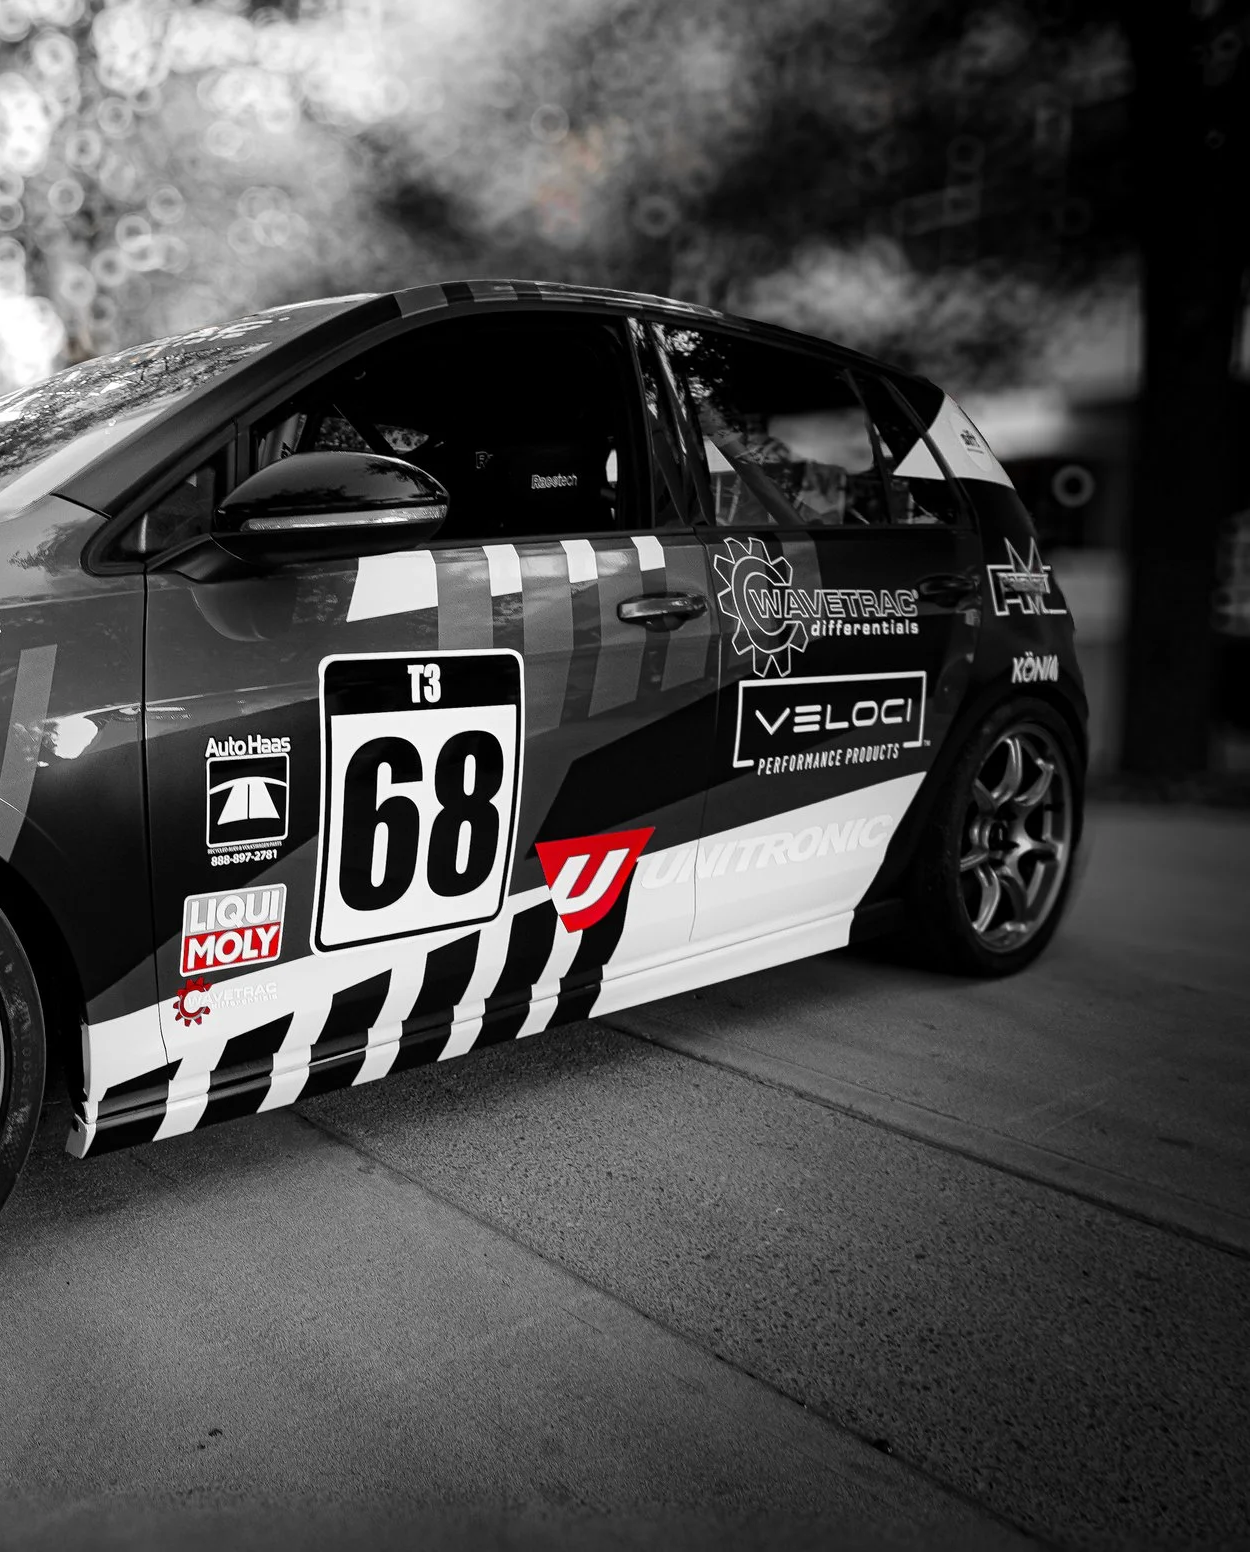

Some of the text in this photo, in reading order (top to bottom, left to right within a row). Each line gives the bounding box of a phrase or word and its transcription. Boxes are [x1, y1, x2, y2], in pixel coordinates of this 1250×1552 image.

[811, 619, 919, 637] differentials
[407, 663, 442, 704] T3
[754, 698, 912, 735] VELOCI
[205, 734, 291, 758] Auto Haas
[757, 743, 901, 776] PERFORMANCE PRODUCTS
[338, 730, 504, 912] 68
[211, 849, 278, 867] 888-897-2781
[641, 813, 894, 890] UNITRONIC
[190, 889, 280, 933] LIQUI
[187, 925, 280, 970] MOLY
